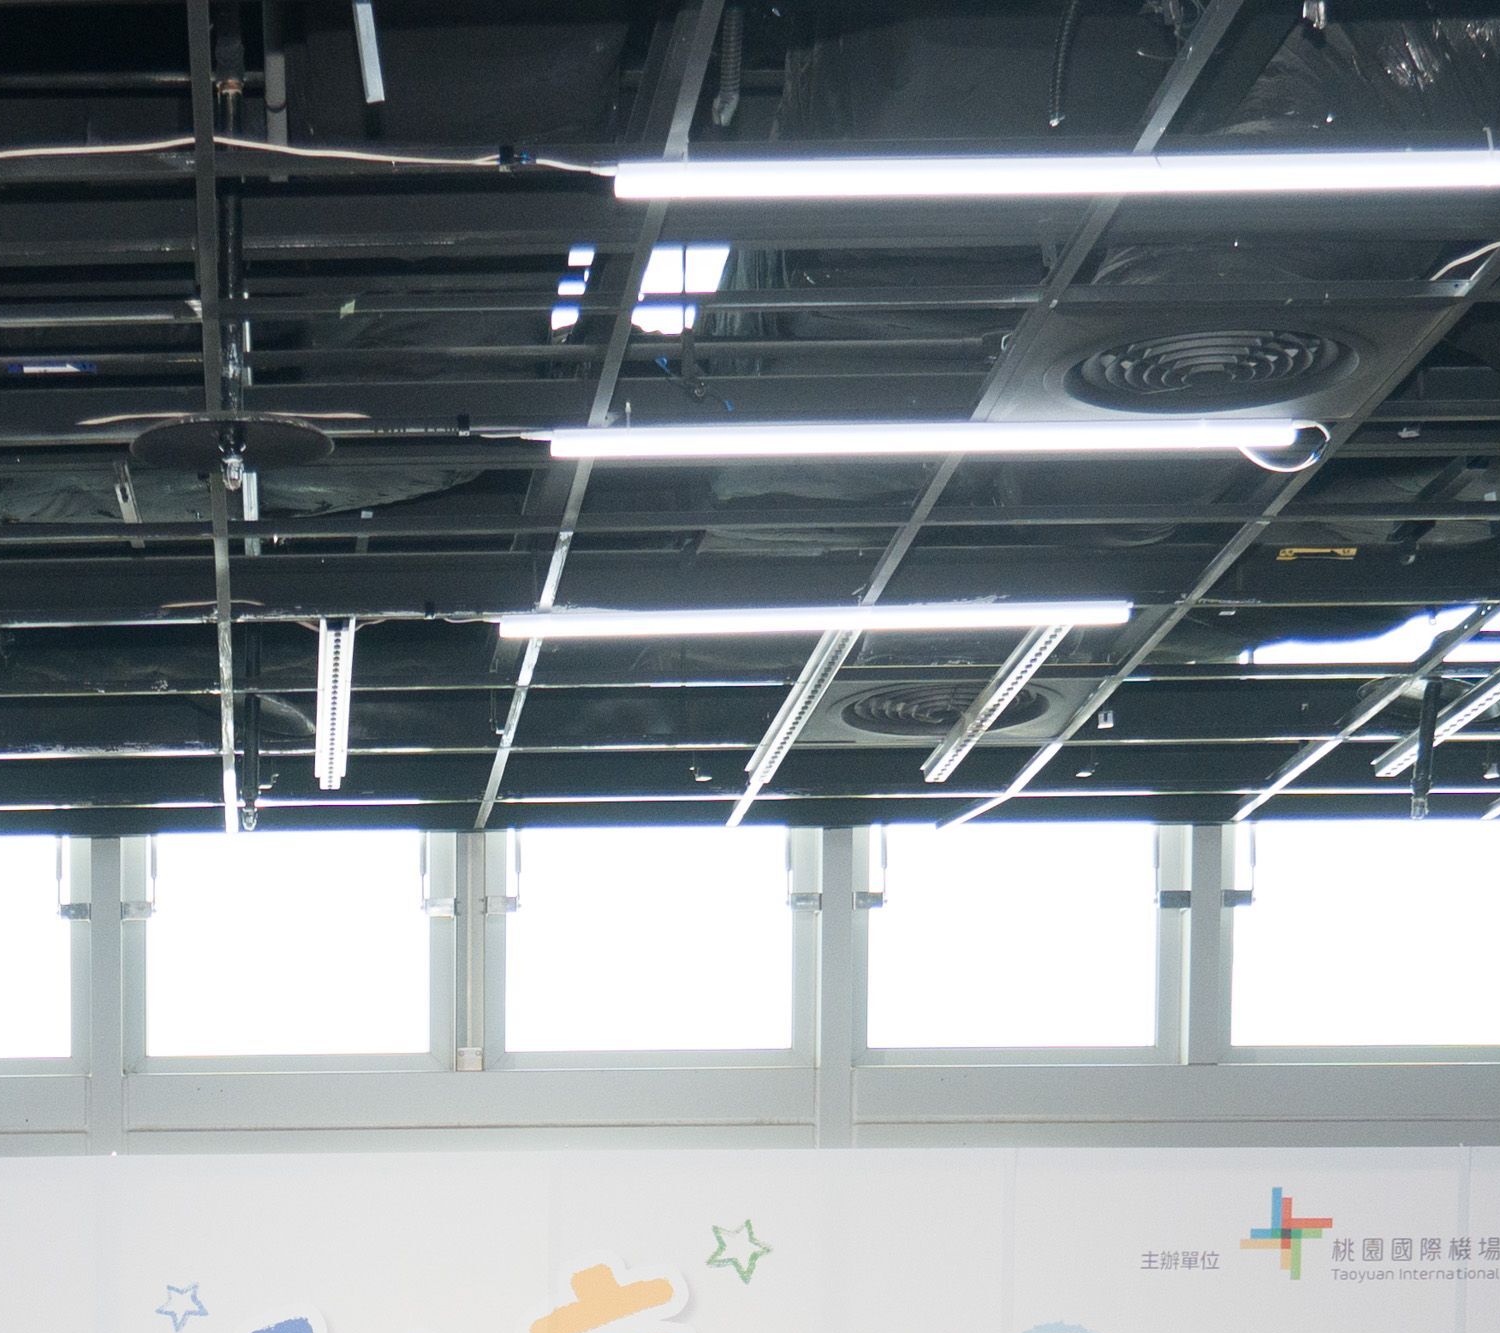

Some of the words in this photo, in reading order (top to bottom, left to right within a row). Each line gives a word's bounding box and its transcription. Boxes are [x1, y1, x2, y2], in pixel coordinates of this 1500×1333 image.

[1140, 1250, 1220, 1271] 主辦單位
[1331, 1268, 1395, 1284] Taoyuan
[1399, 1267, 1500, 1281] International
